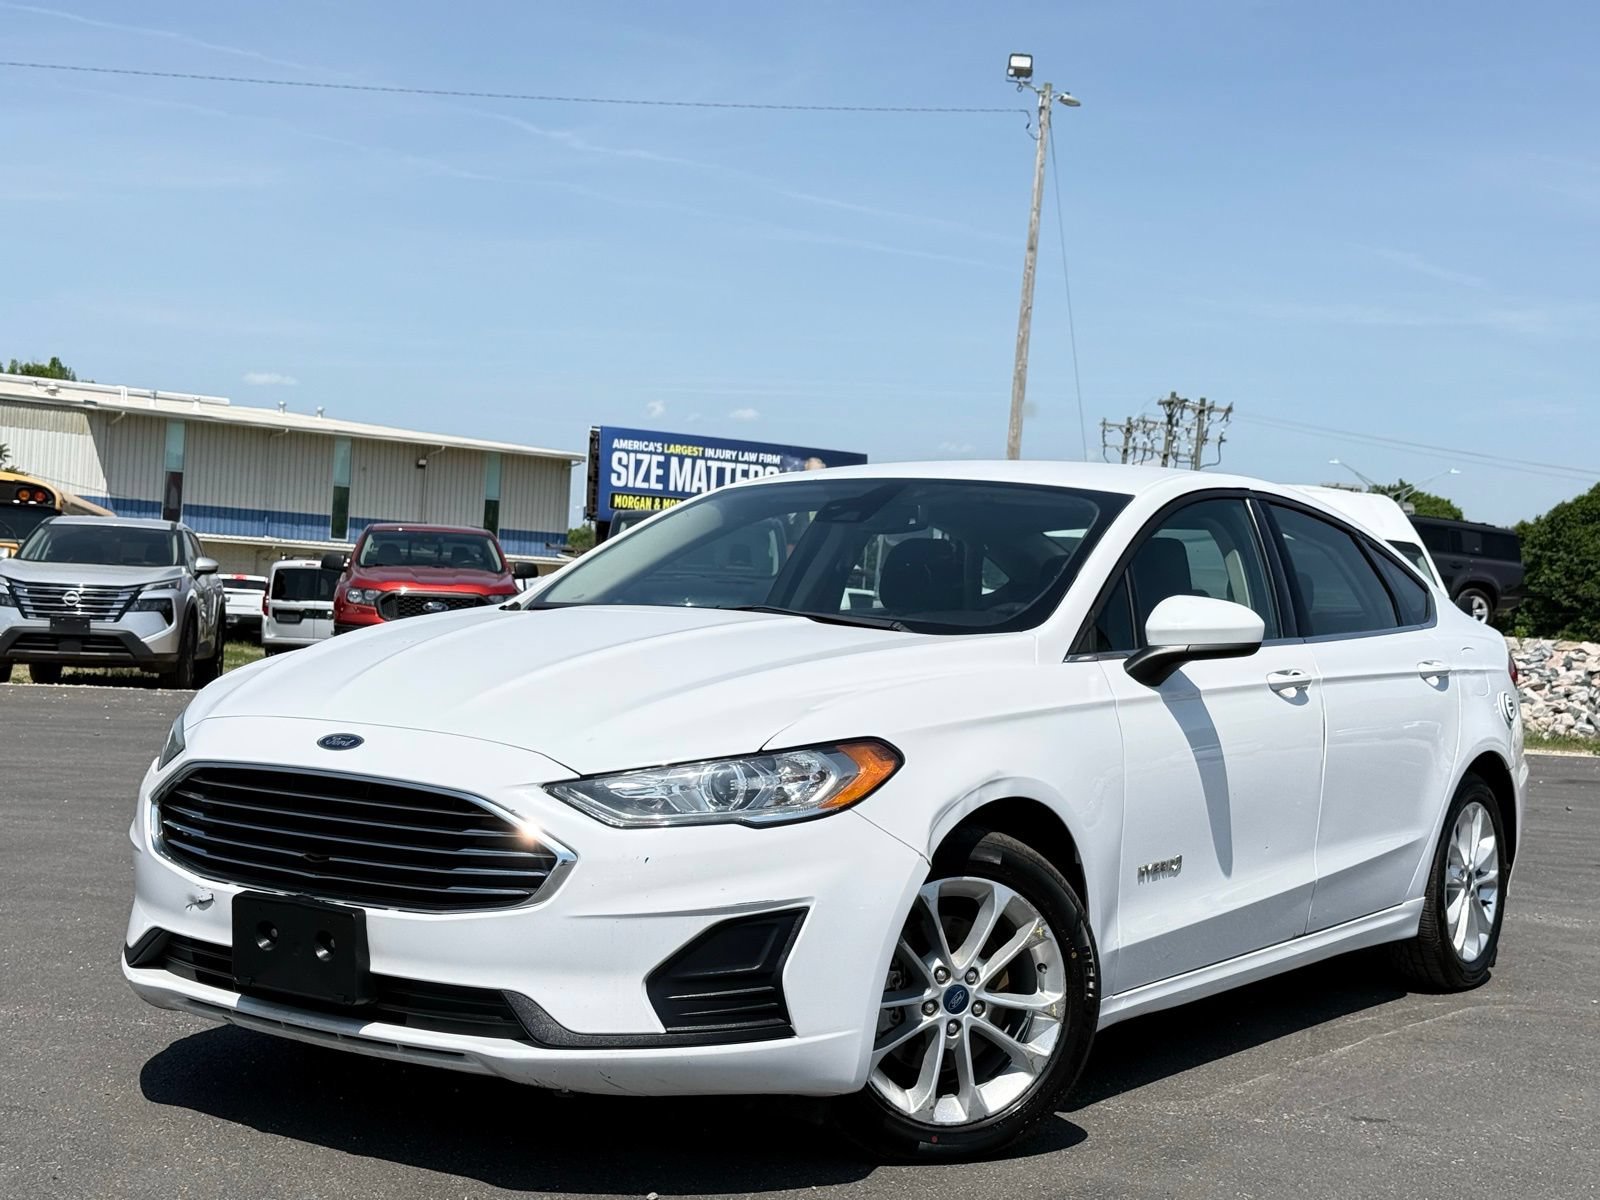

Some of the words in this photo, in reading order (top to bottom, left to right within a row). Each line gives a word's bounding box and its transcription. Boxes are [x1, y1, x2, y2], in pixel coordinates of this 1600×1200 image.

[612, 438, 663, 453] AMERICA'S
[664, 443, 704, 457] LARGEST
[704, 448, 737, 461] INJURY
[738, 451, 758, 463] LAW
[610, 451, 665, 490] SIZE
[614, 494, 652, 511] MORGAN
[653, 498, 661, 511] &
[1137, 855, 1182, 880] HYBRID
